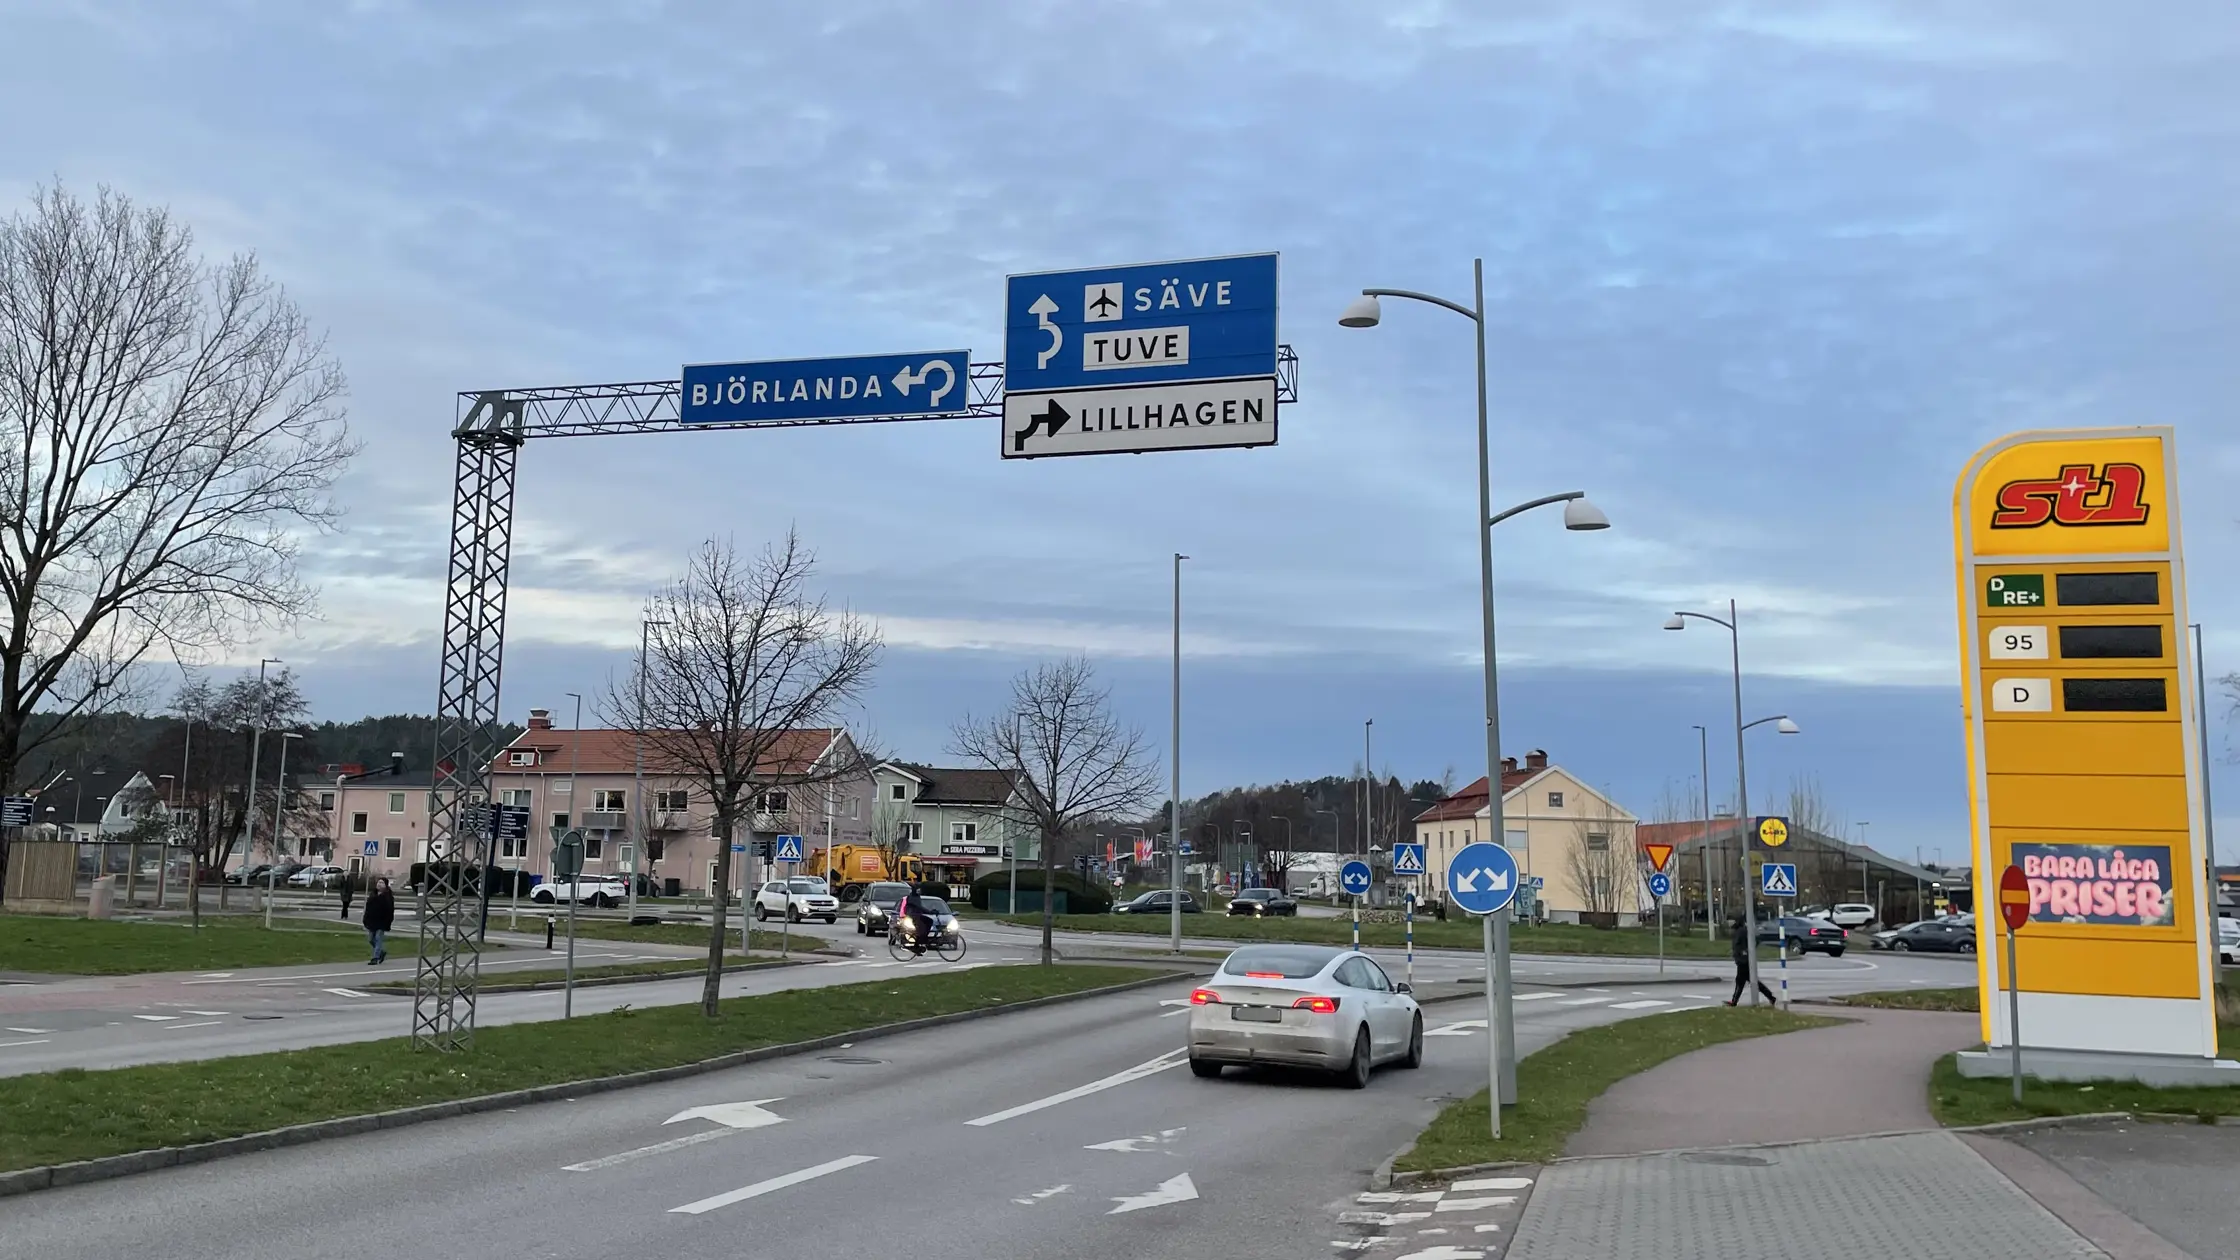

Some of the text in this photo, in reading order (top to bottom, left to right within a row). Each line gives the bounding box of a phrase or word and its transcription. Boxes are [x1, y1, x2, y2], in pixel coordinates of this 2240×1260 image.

[1134, 278, 1233, 312] SÄVE
[1093, 334, 1180, 363] TUVE
[691, 373, 883, 407] BJÖRLANDA
[1081, 398, 1265, 432] LILLHAGEN
[1990, 577, 2005, 592] D
[2003, 590, 2040, 605] RE+
[2004, 634, 2033, 650] 95
[2013, 686, 2029, 703] D
[2024, 850, 2160, 881] BARA LÅGA
[2028, 879, 2166, 918] PRISER
